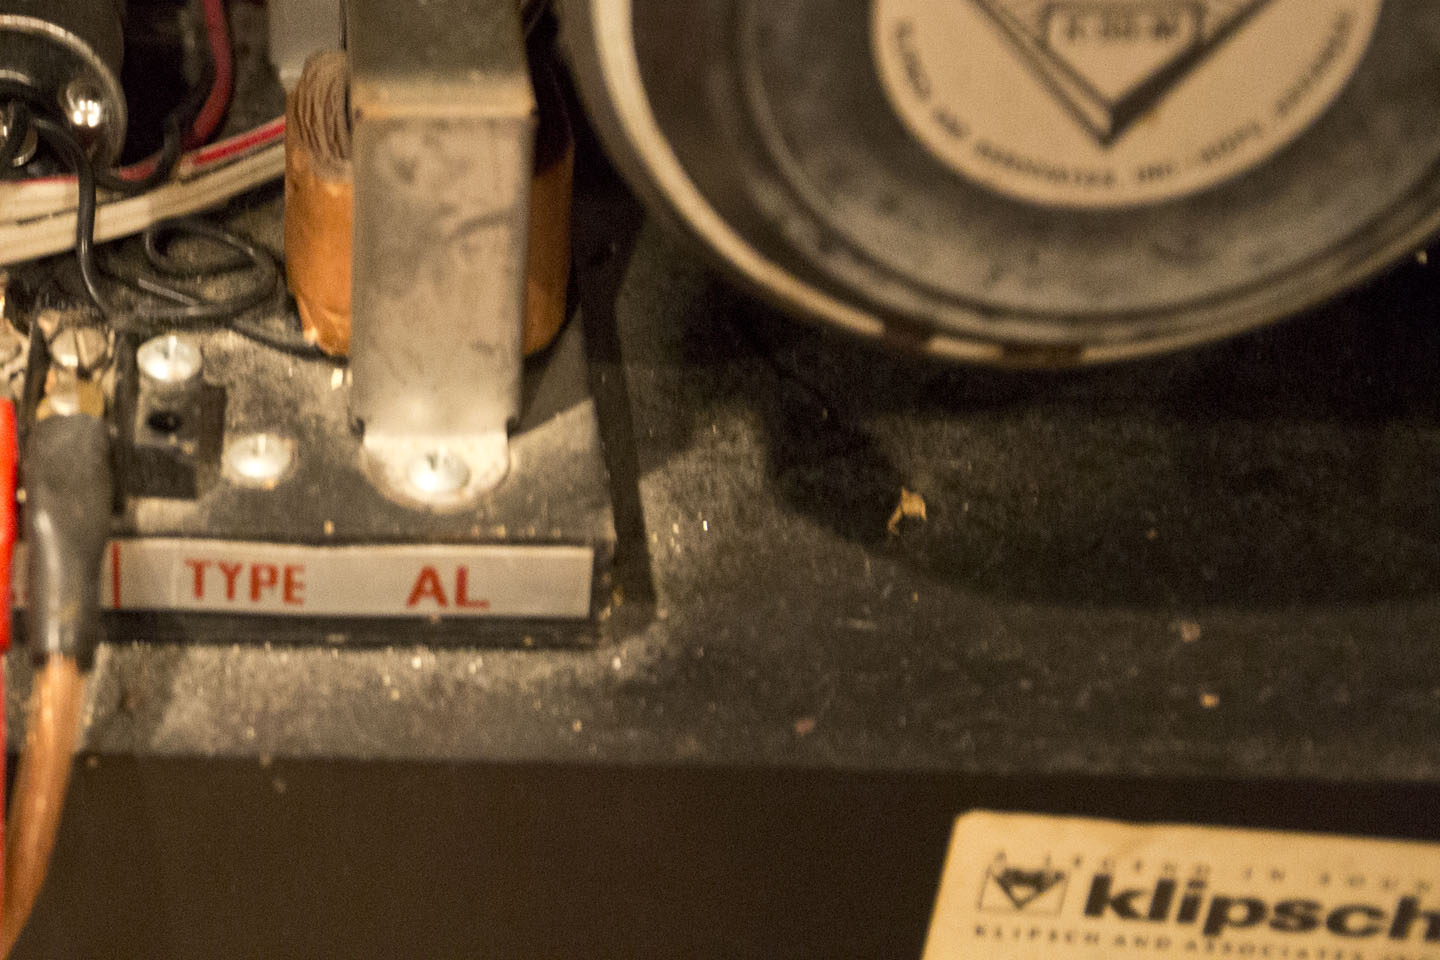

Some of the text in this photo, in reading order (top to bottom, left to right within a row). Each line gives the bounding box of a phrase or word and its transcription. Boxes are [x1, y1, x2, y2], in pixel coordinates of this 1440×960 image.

[185, 559, 490, 608] TYPE AL
[1083, 873, 1440, 943] klipsch
